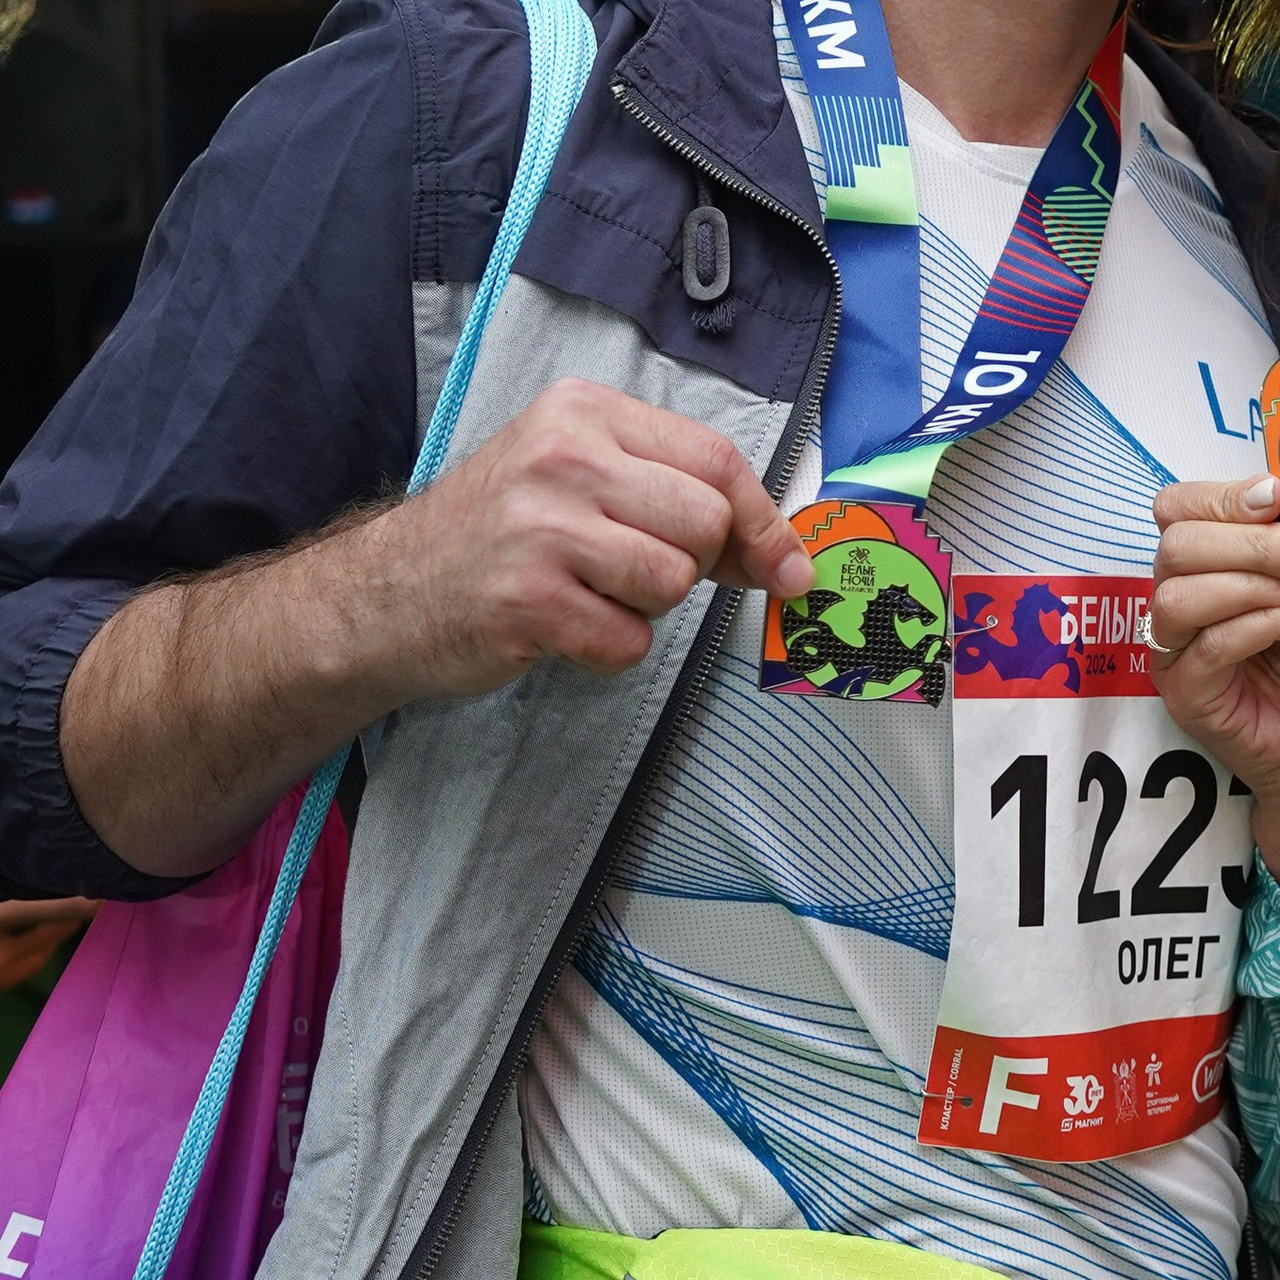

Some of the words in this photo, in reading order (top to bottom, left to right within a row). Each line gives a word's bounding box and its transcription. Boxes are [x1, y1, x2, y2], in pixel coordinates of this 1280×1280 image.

[963, 350, 1042, 396] 10
[840, 575, 875, 586] НОЧИ
[841, 564, 876, 576] БЕЛЫЕ
[1060, 595, 1147, 645] БЕЛЫЕ
[1086, 653, 1117, 675] 2024
[1118, 935, 1221, 985] ОЛЕГ
[949, 1047, 964, 1081] CORRAL
[979, 1054, 1049, 1136] F
[1063, 1074, 1101, 1116] 30
